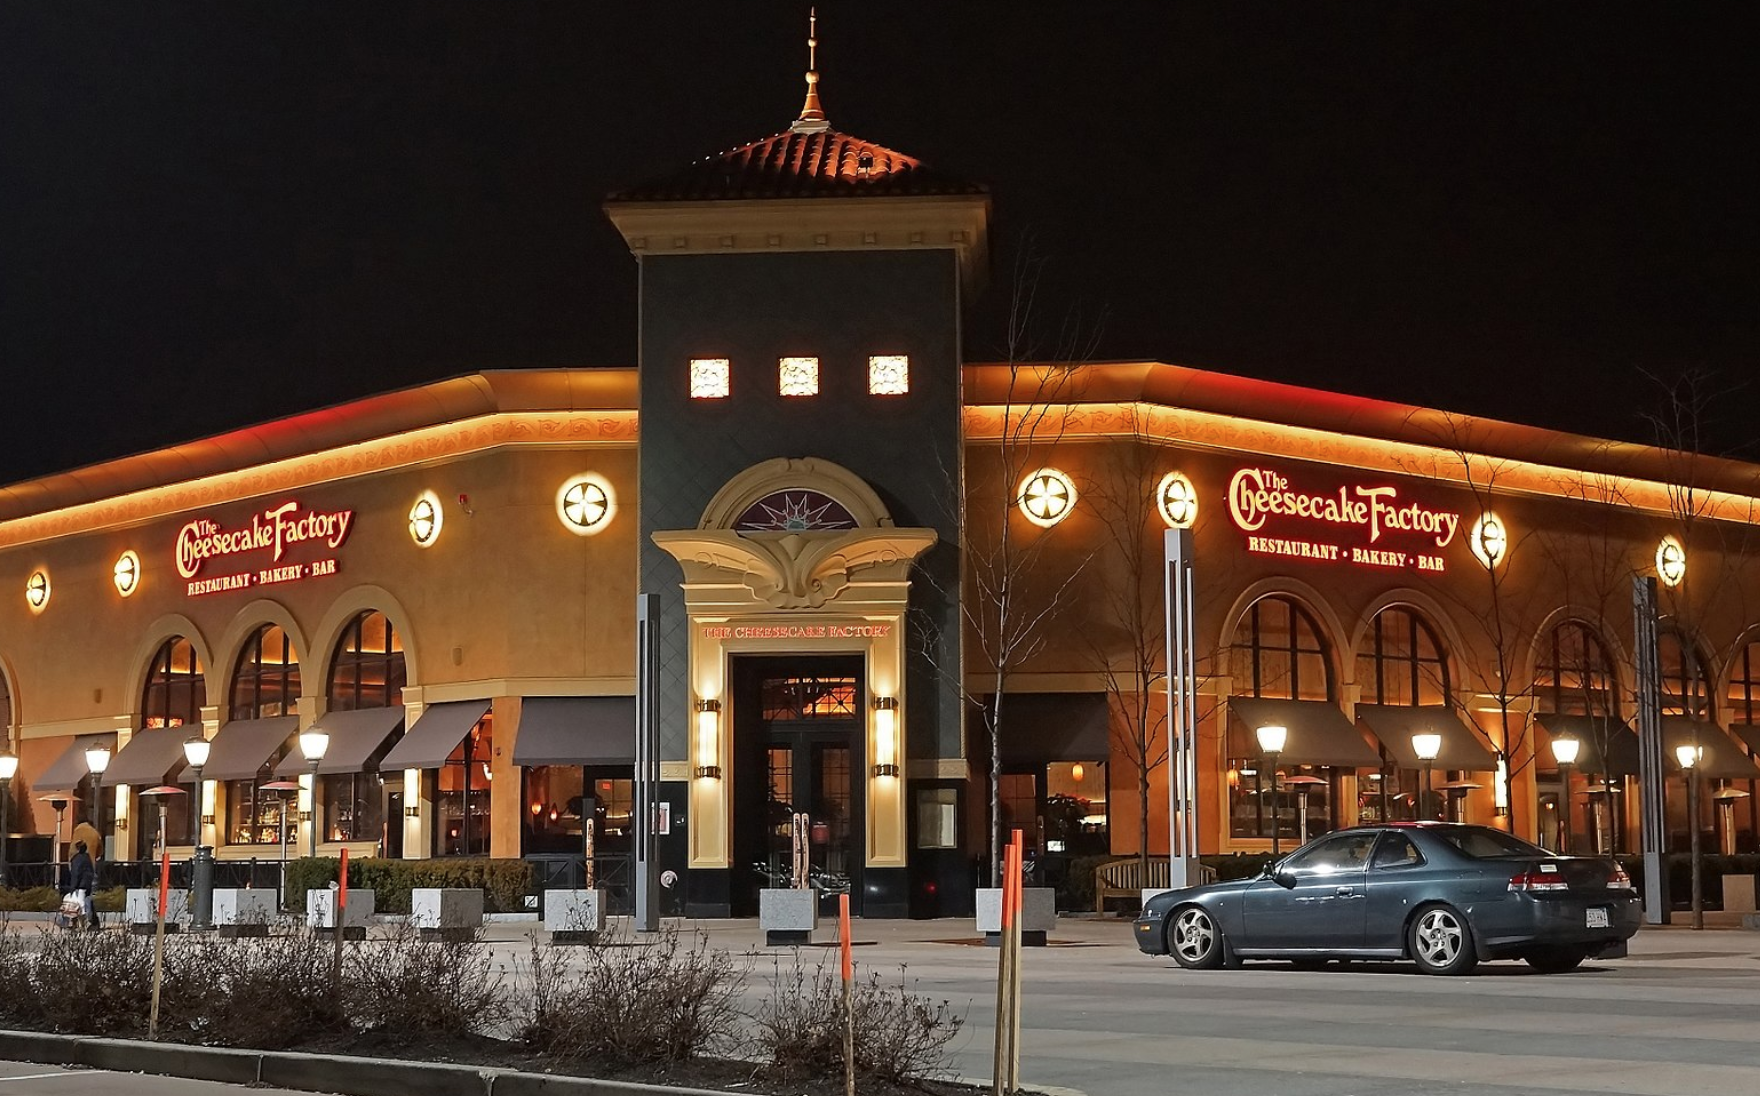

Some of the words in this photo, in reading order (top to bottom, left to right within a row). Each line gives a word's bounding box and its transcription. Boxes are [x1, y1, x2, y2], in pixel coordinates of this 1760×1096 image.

[1262, 470, 1288, 492] The
[1229, 468, 1368, 531] Cheesecake
[1356, 486, 1459, 547] Factory
[176, 514, 274, 578] Cheesecake
[265, 502, 352, 562] Factory
[199, 519, 217, 537] The
[1249, 536, 1338, 560] RESTAURANT
[1353, 548, 1406, 567] BAKERY
[1418, 555, 1445, 571] BAR
[187, 573, 250, 596] RESTAURANT
[259, 564, 303, 585] BAKERY
[312, 559, 336, 576] BAR
[702, 627, 732, 639] THE
[734, 626, 825, 638] CHEESECAKE
[828, 625, 892, 638] FACTORY
